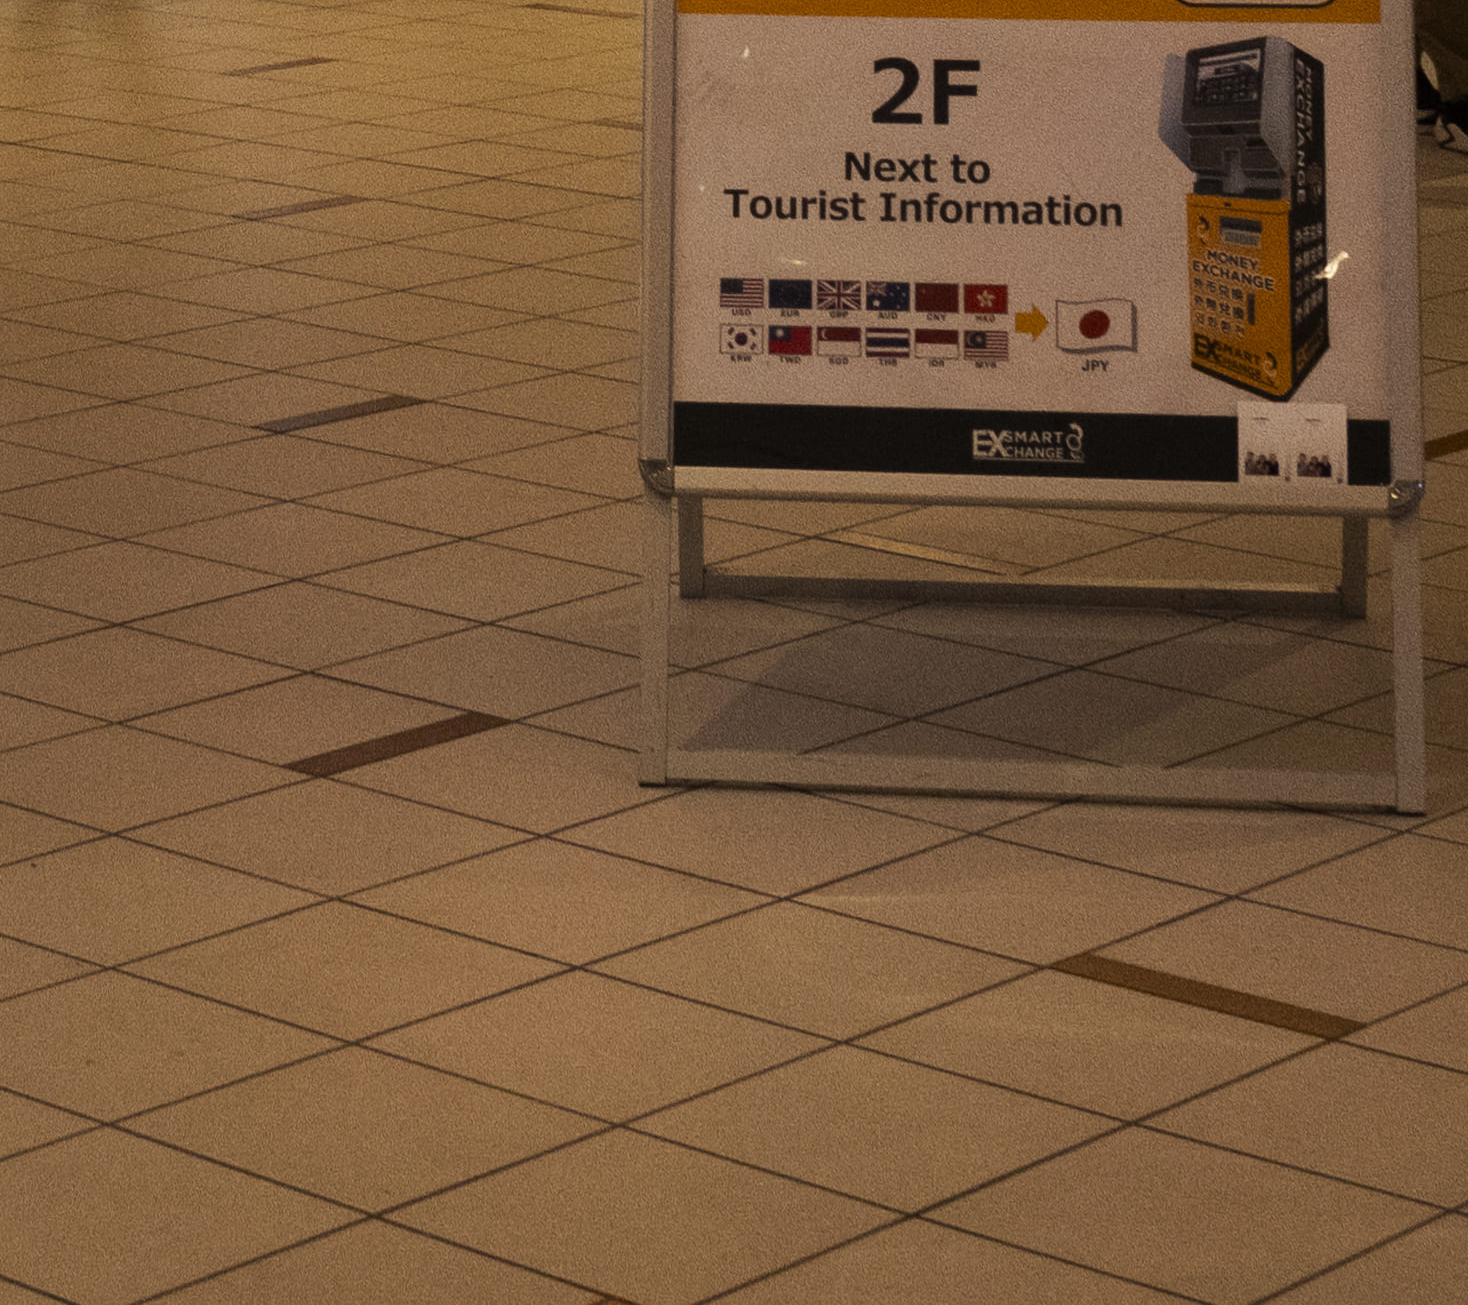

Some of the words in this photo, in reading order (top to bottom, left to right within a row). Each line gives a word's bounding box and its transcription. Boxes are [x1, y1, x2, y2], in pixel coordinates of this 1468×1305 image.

[871, 57, 981, 126] 2F
[844, 152, 936, 183] Next
[950, 155, 990, 184] to
[724, 190, 866, 221] Tourist
[880, 190, 1123, 228] Information
[1193, 260, 1274, 291] EXCHANGE
[1207, 250, 1257, 270] MONEY
[1081, 359, 1109, 372] JPY
[1004, 431, 1062, 444] SMART
